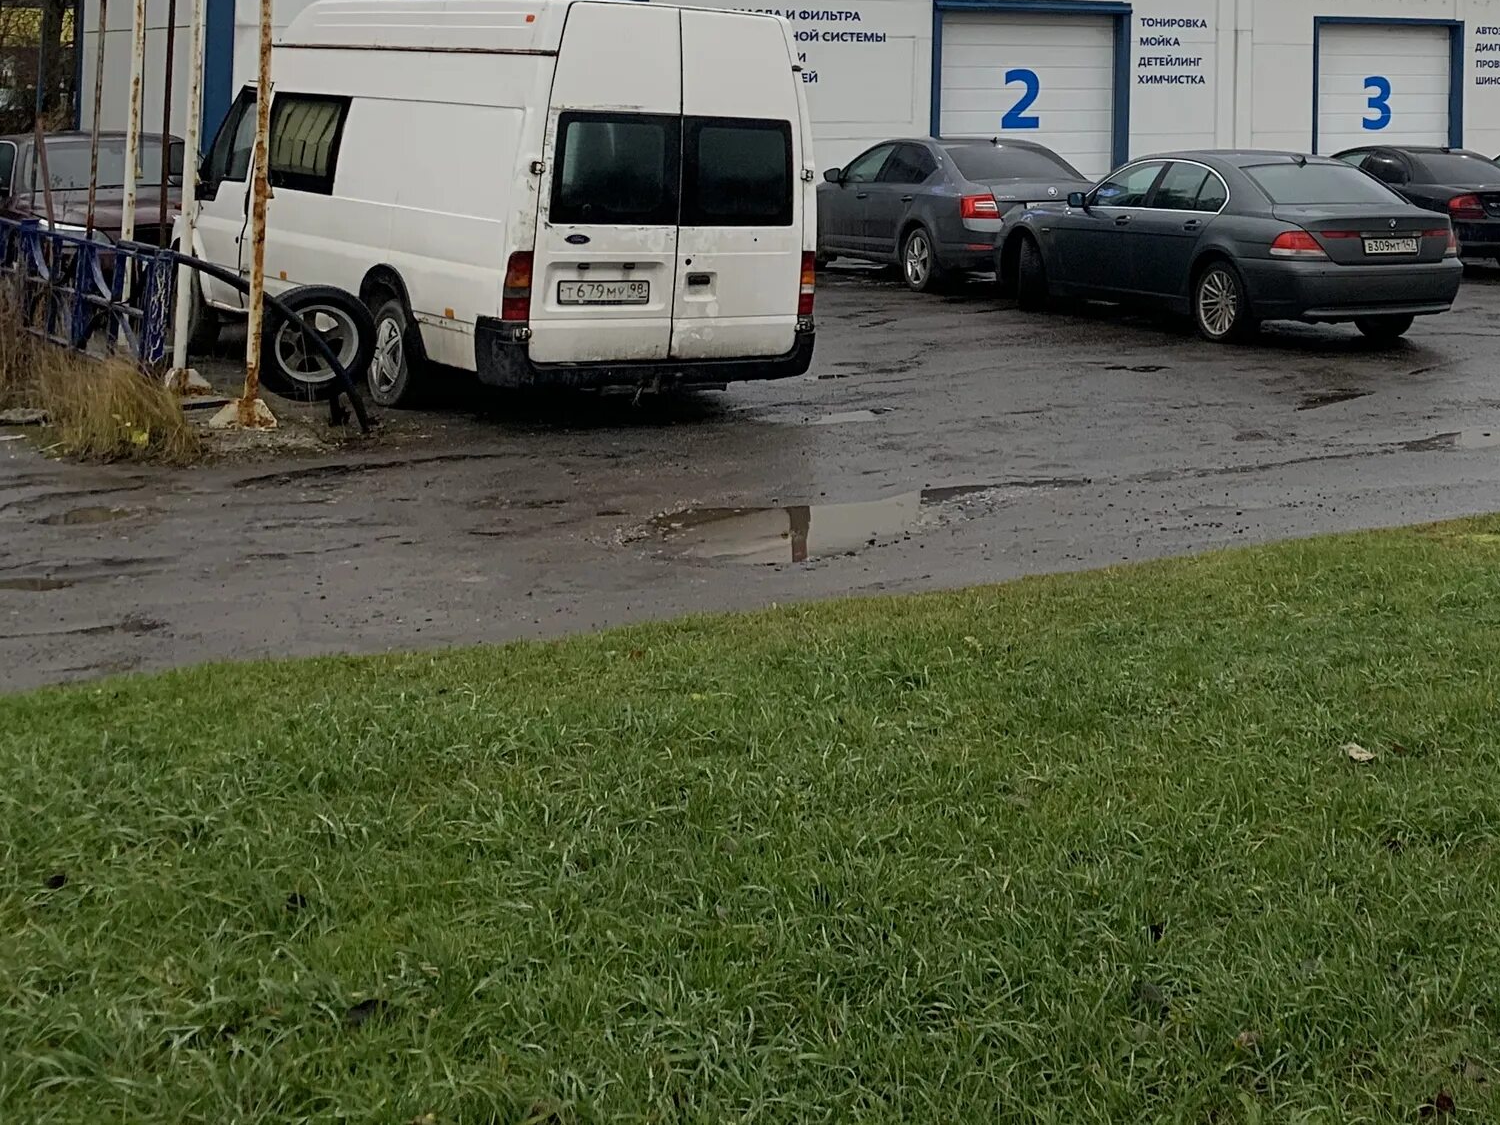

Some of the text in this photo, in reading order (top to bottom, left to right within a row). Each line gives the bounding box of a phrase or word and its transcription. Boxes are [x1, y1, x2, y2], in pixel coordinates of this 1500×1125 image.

[786, 9, 796, 20] И
[799, 10, 861, 21] ФИЛЬТРА
[1140, 18, 1208, 29] ТОНИРОВКА
[822, 31, 887, 43] СИСТЕМЫ
[1139, 36, 1181, 47] МОЙКА
[1137, 54, 1203, 67] ДЕТЕЙЛИНГ
[1137, 75, 1206, 85] ХИМЧИСТКА
[1001, 68, 1040, 129] 2
[1362, 76, 1392, 130] 3
[630, 283, 644, 295] 98
